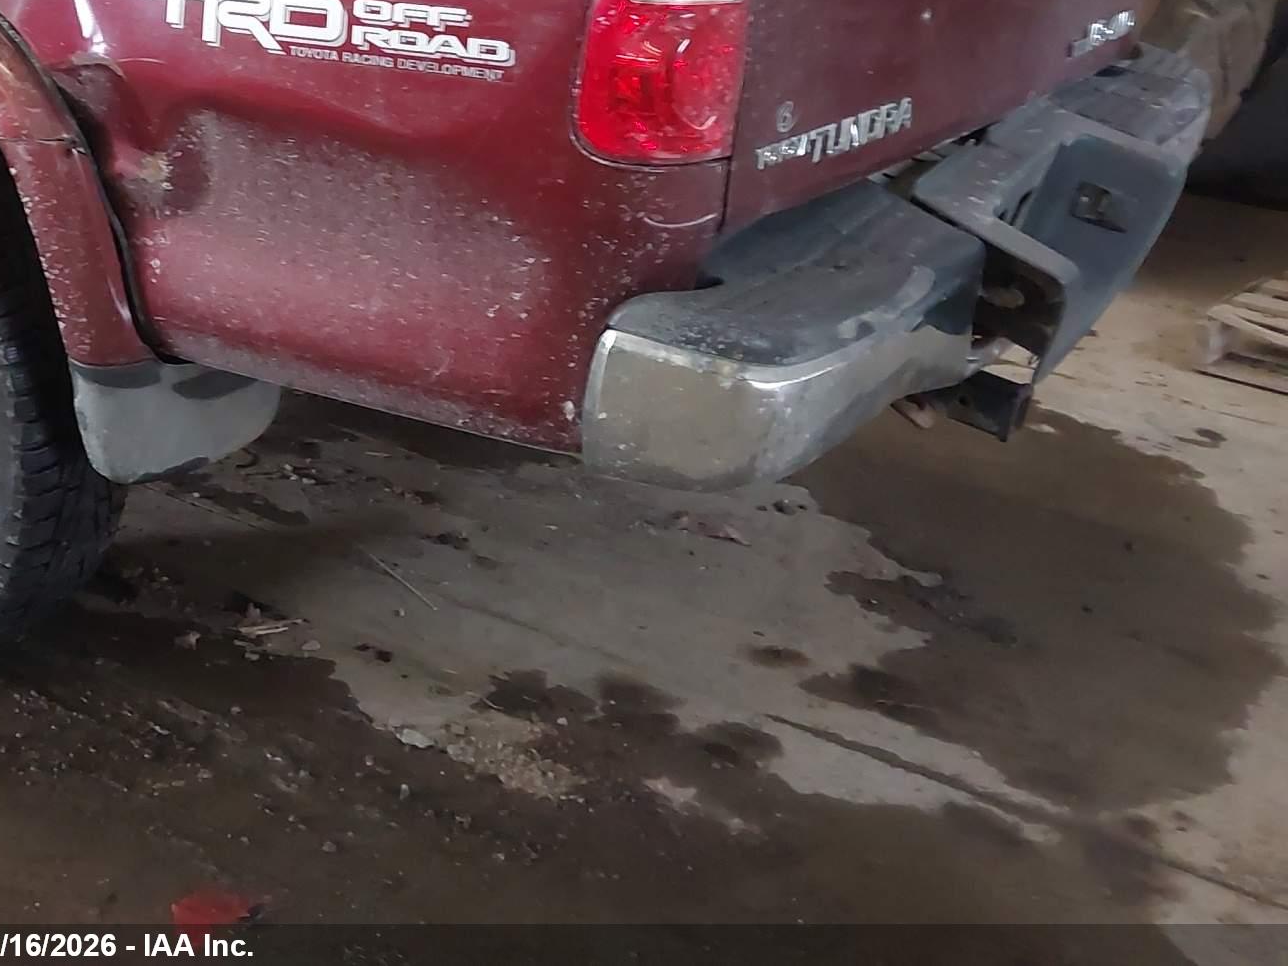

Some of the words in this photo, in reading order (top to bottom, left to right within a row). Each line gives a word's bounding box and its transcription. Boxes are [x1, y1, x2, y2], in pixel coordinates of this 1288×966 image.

[353, 0, 472, 32] OFF
[289, 45, 339, 61] TOYOTA
[342, 51, 394, 68] RACING
[396, 60, 505, 82] DEVELOPMENT
[351, 24, 516, 67] ROAD
[807, 97, 912, 164] TUNDRA
